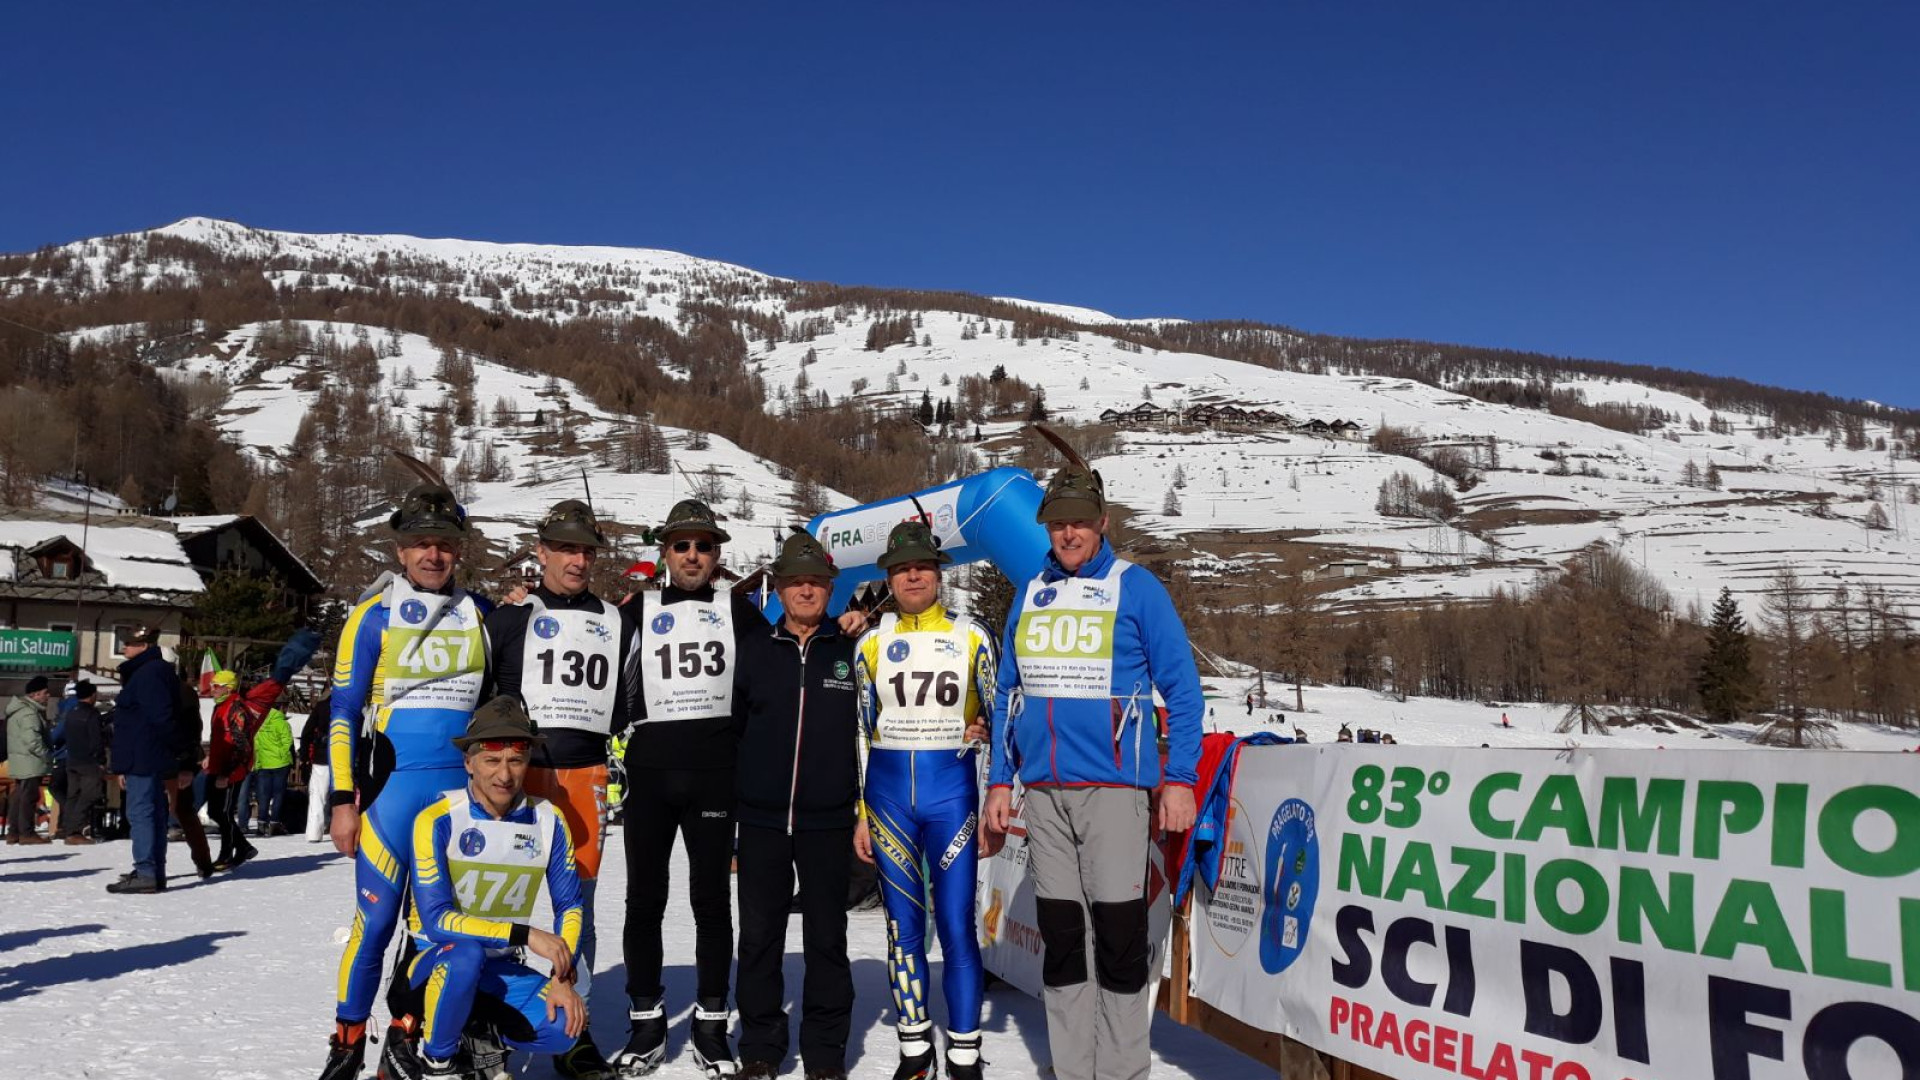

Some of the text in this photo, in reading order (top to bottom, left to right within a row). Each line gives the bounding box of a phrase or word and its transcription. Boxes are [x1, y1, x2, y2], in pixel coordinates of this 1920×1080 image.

[21, 637, 71, 657] Salumi
[1025, 615, 1103, 654] 505
[398, 635, 470, 674] 467
[537, 649, 609, 690] 130
[655, 641, 726, 680] 153
[889, 671, 959, 707] 176
[1271, 803, 1306, 840] PRAGELATO
[455, 870, 531, 912] 474
[1331, 905, 1475, 1017] SCI
[1520, 939, 1650, 1065] DI
